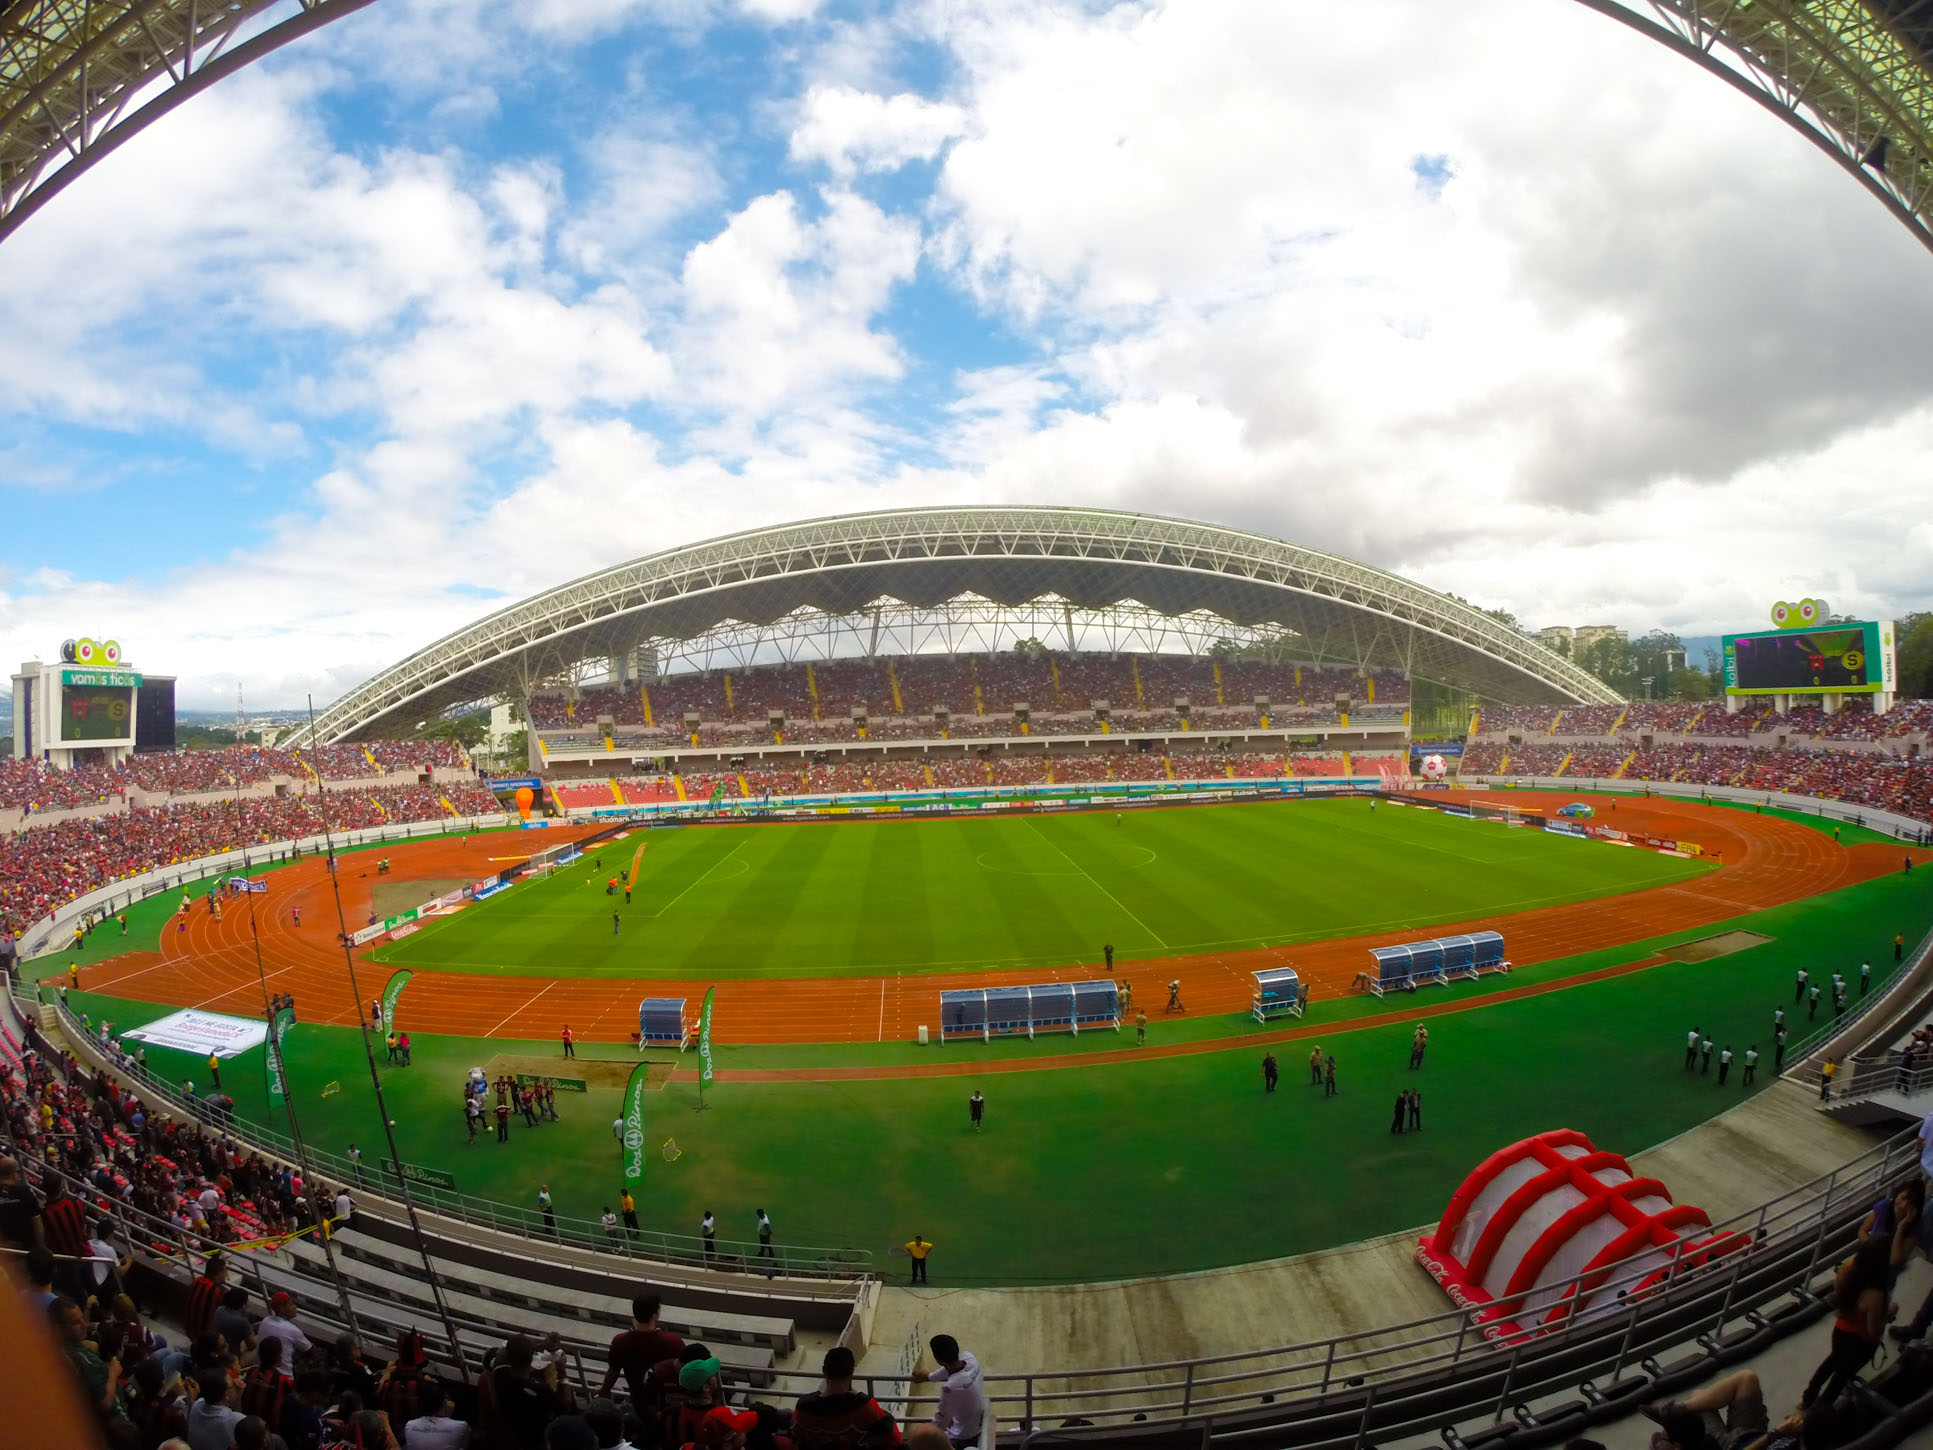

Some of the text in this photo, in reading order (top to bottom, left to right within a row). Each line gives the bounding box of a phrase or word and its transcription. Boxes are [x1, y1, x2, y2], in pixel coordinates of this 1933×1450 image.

[71, 673, 135, 686] vamos ticos
[1681, 844, 1697, 855] EPA
[702, 1003, 713, 1080] Dos Pinos
[625, 1079, 643, 1178] Dos Pinos
